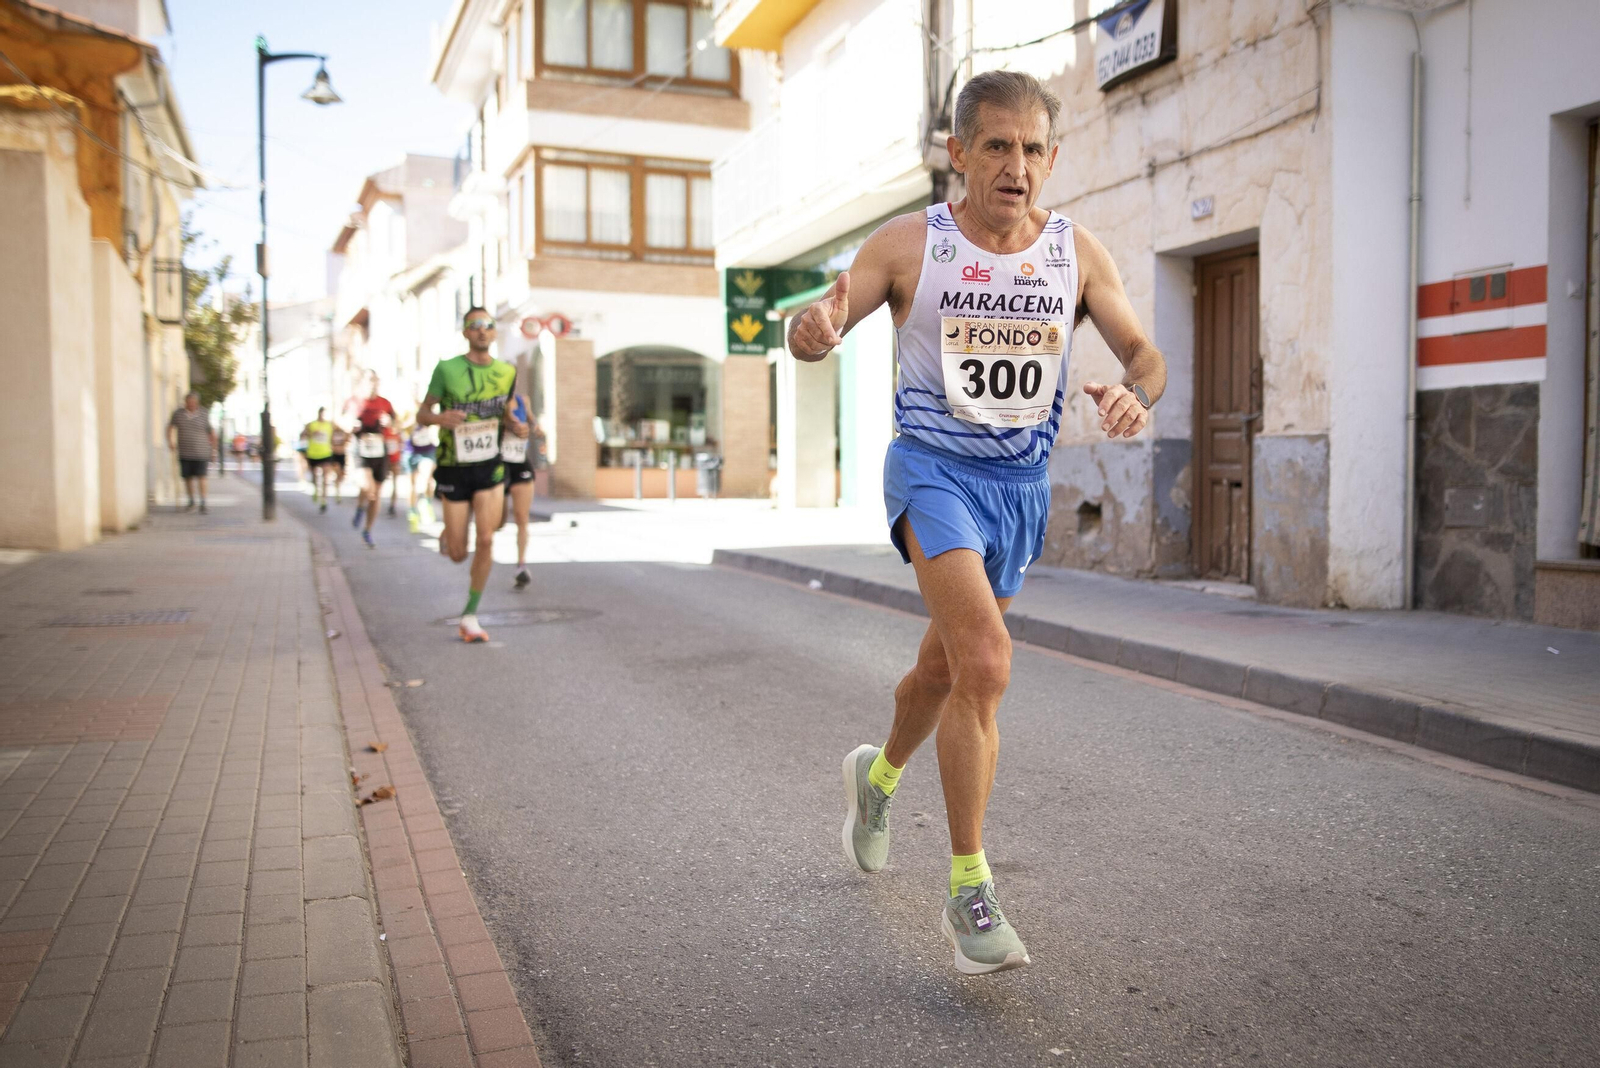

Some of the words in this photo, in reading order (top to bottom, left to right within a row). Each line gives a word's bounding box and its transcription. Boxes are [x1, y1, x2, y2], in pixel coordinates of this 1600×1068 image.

[939, 291, 1064, 315] MARACENA
[970, 321, 995, 330] GRAN
[997, 323, 1030, 331] PREMIO
[968, 328, 1042, 346] FONDO
[958, 358, 1043, 400] 300
